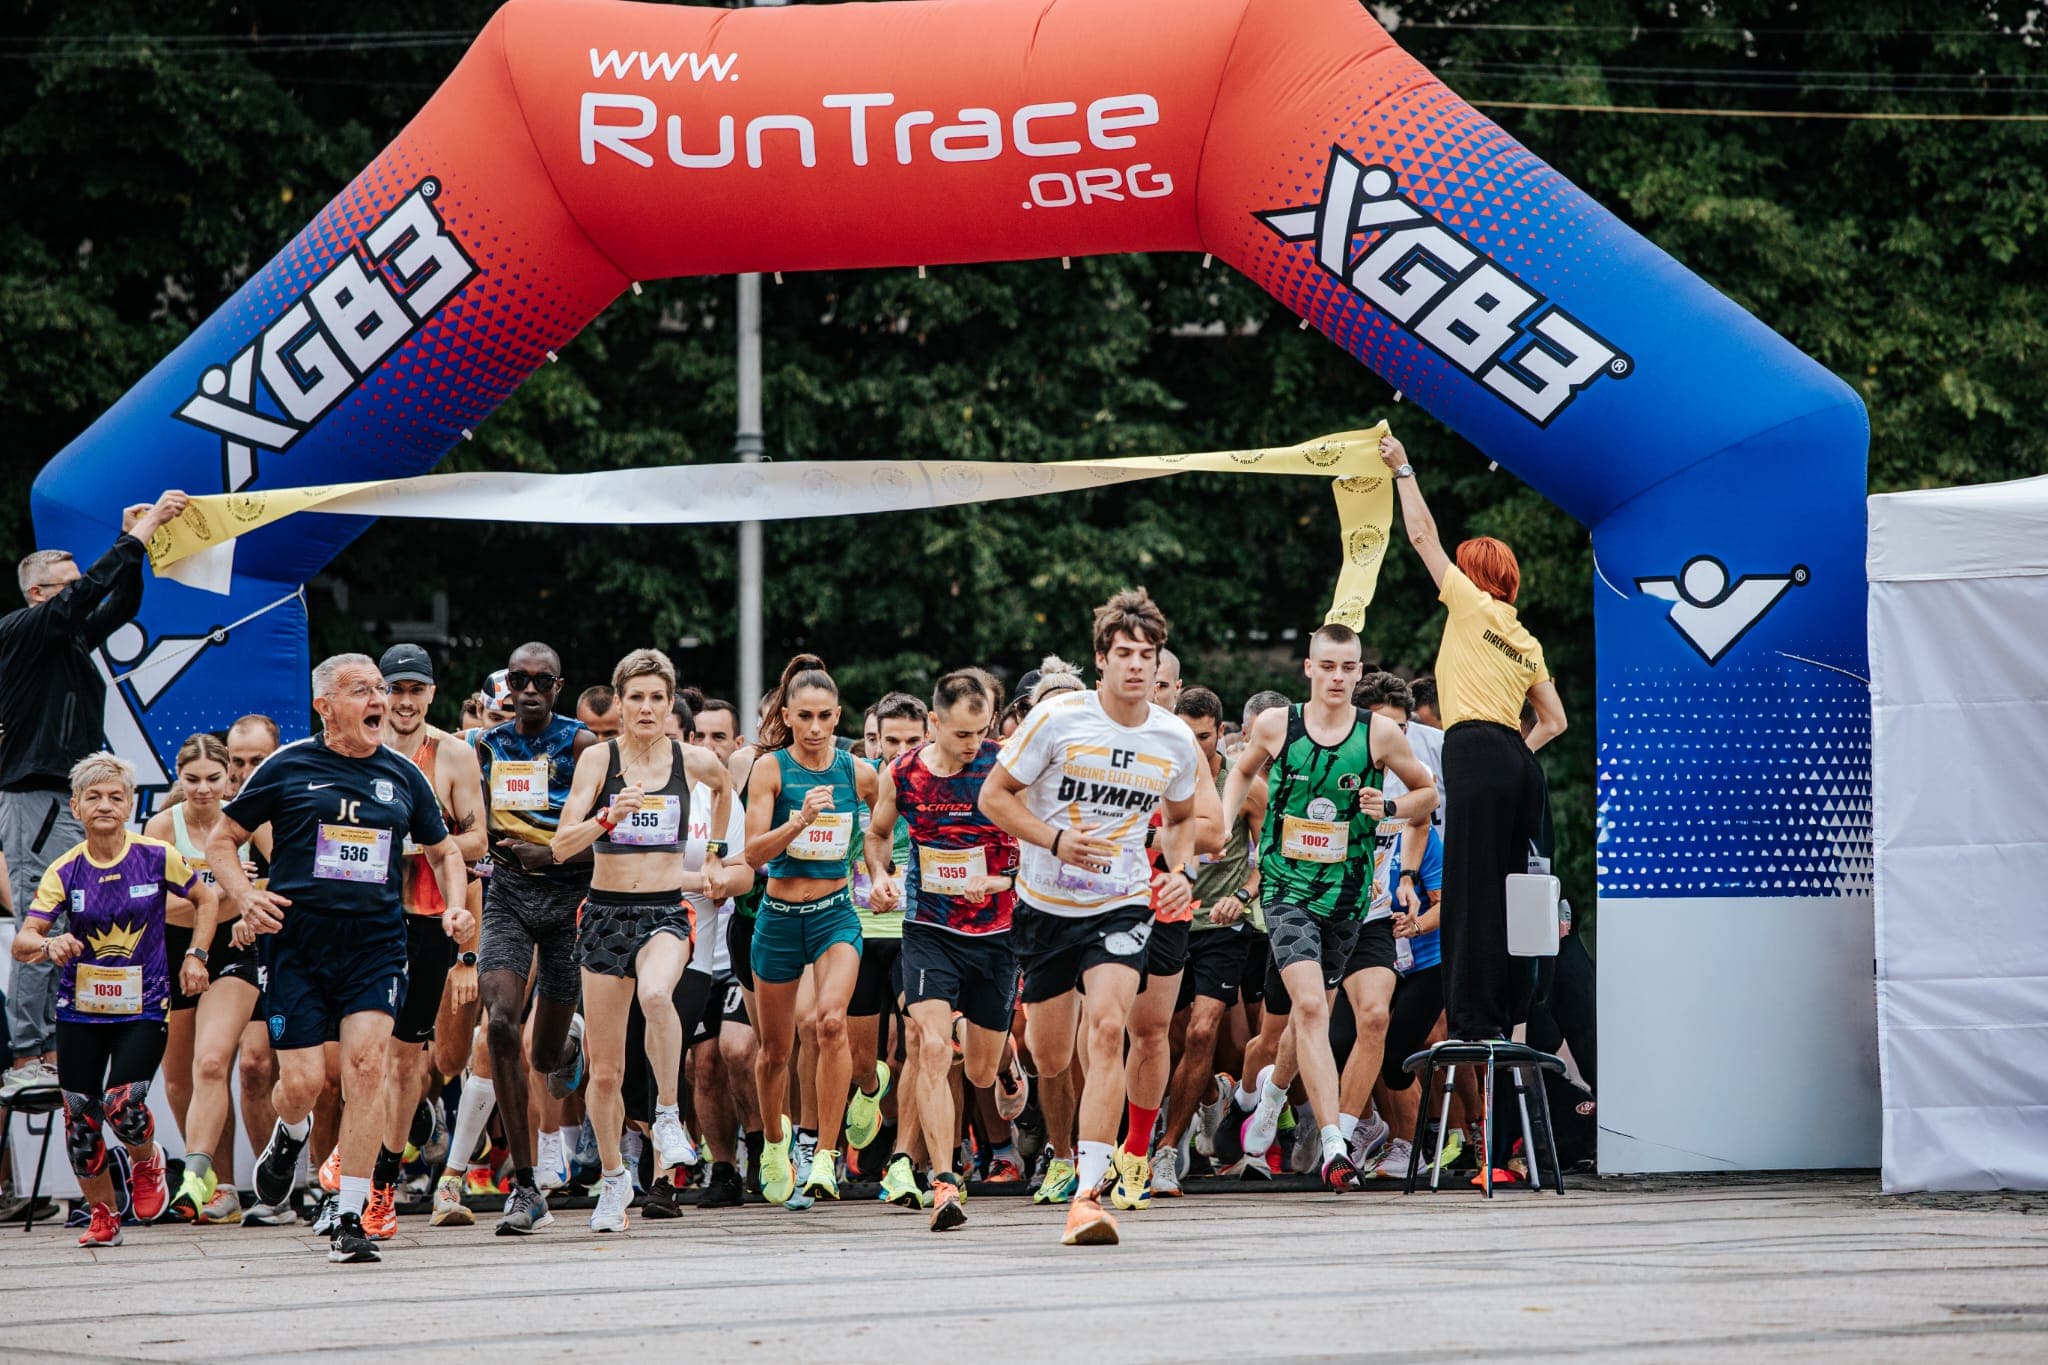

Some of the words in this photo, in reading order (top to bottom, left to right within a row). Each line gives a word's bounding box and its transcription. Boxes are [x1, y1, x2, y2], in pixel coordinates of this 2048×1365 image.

[590, 48, 740, 82] www.
[579, 91, 1160, 169] RunTrace
[1021, 162, 1174, 210] .ORG
[1111, 748, 1136, 769] CF
[506, 779, 530, 792] 1094
[336, 798, 361, 824] JC
[631, 812, 659, 828] 555
[808, 830, 834, 843] 1314
[1300, 834, 1329, 848] 1002
[339, 845, 370, 863] 536
[937, 866, 967, 879] 1359
[93, 983, 123, 997] 1030
